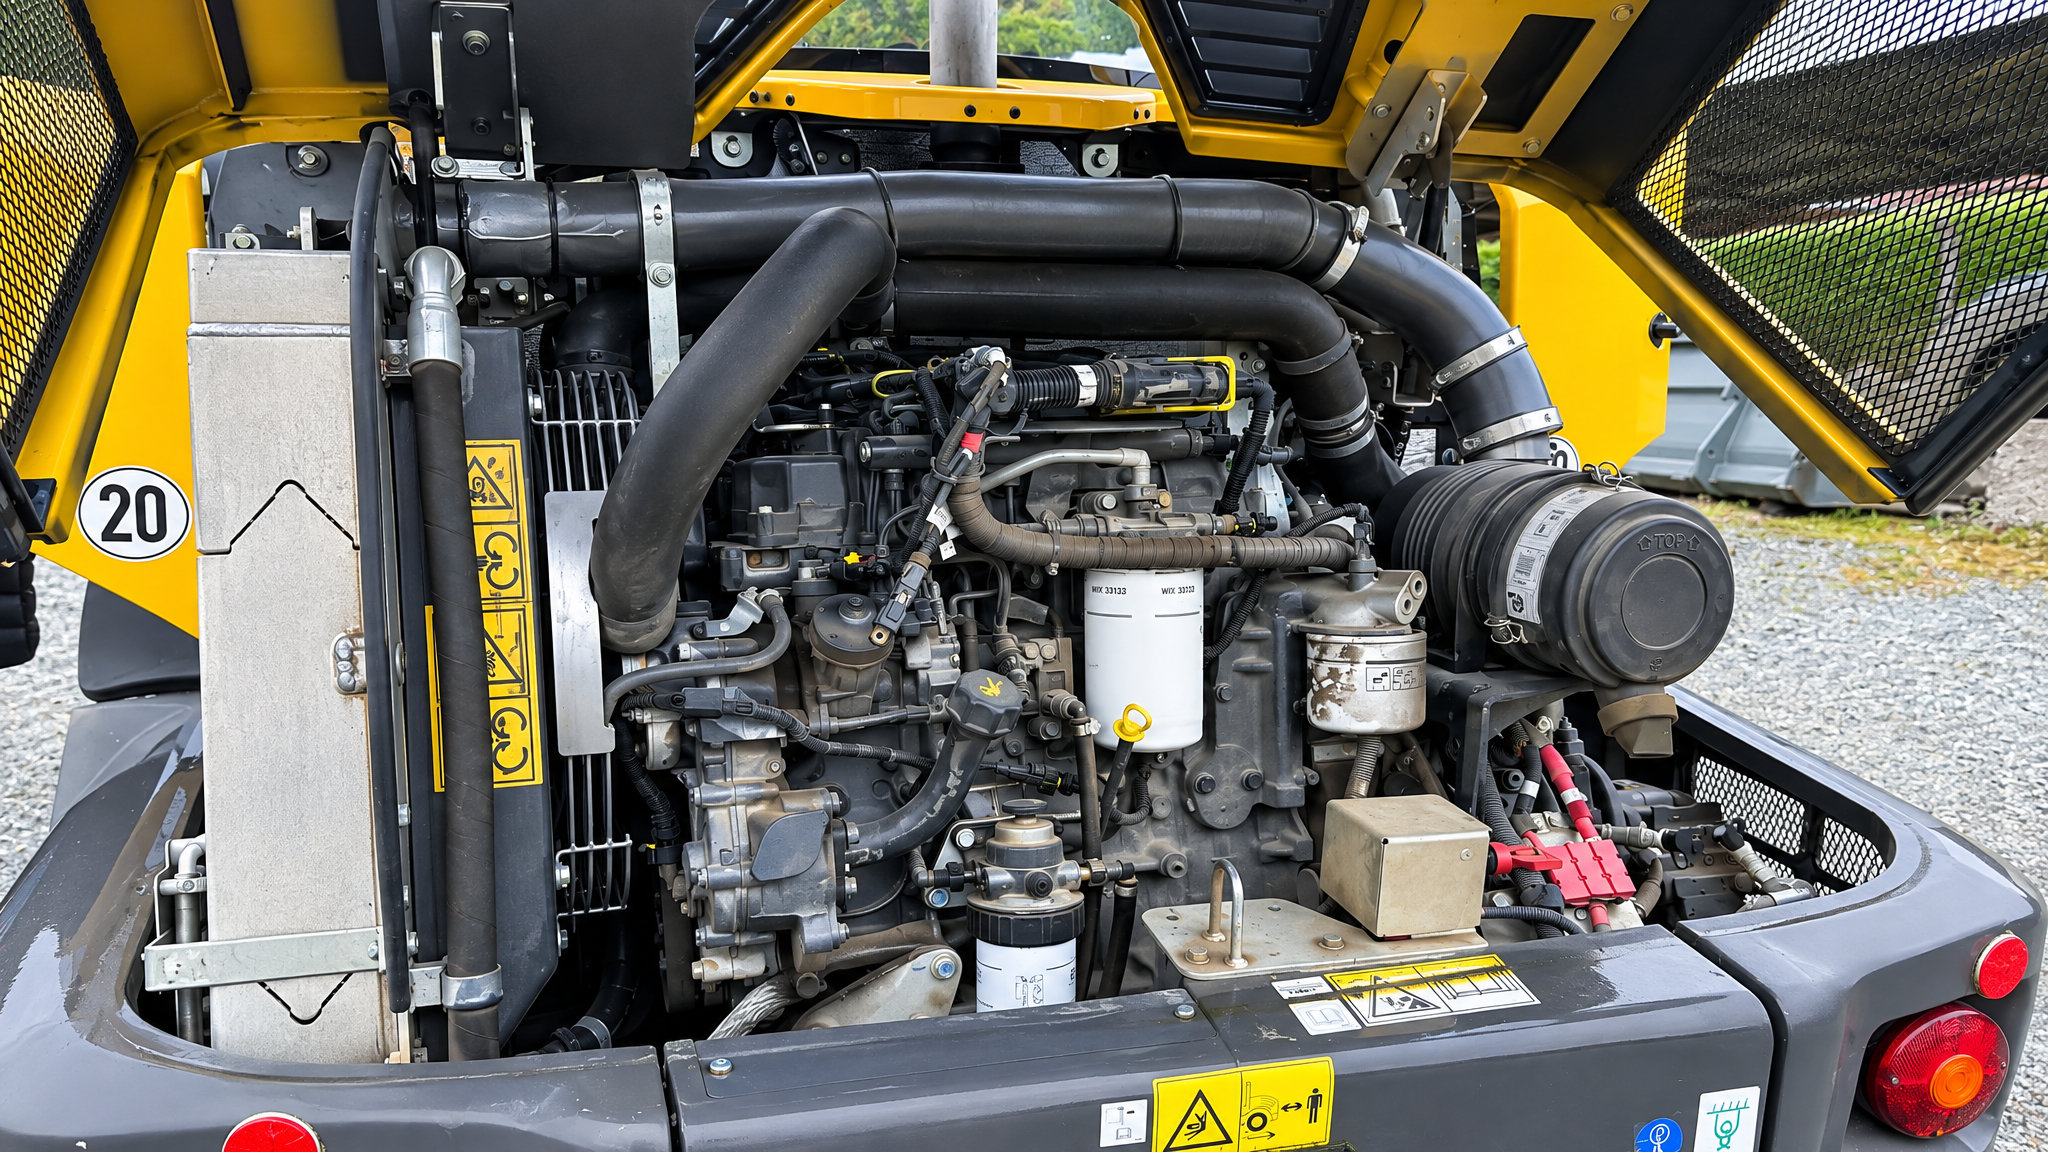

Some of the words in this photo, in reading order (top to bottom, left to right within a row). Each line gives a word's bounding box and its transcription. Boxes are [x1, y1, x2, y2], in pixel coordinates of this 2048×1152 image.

[99, 483, 167, 543] 20
[1652, 532, 1687, 551] TOP
[1161, 587, 1176, 595] WIX
